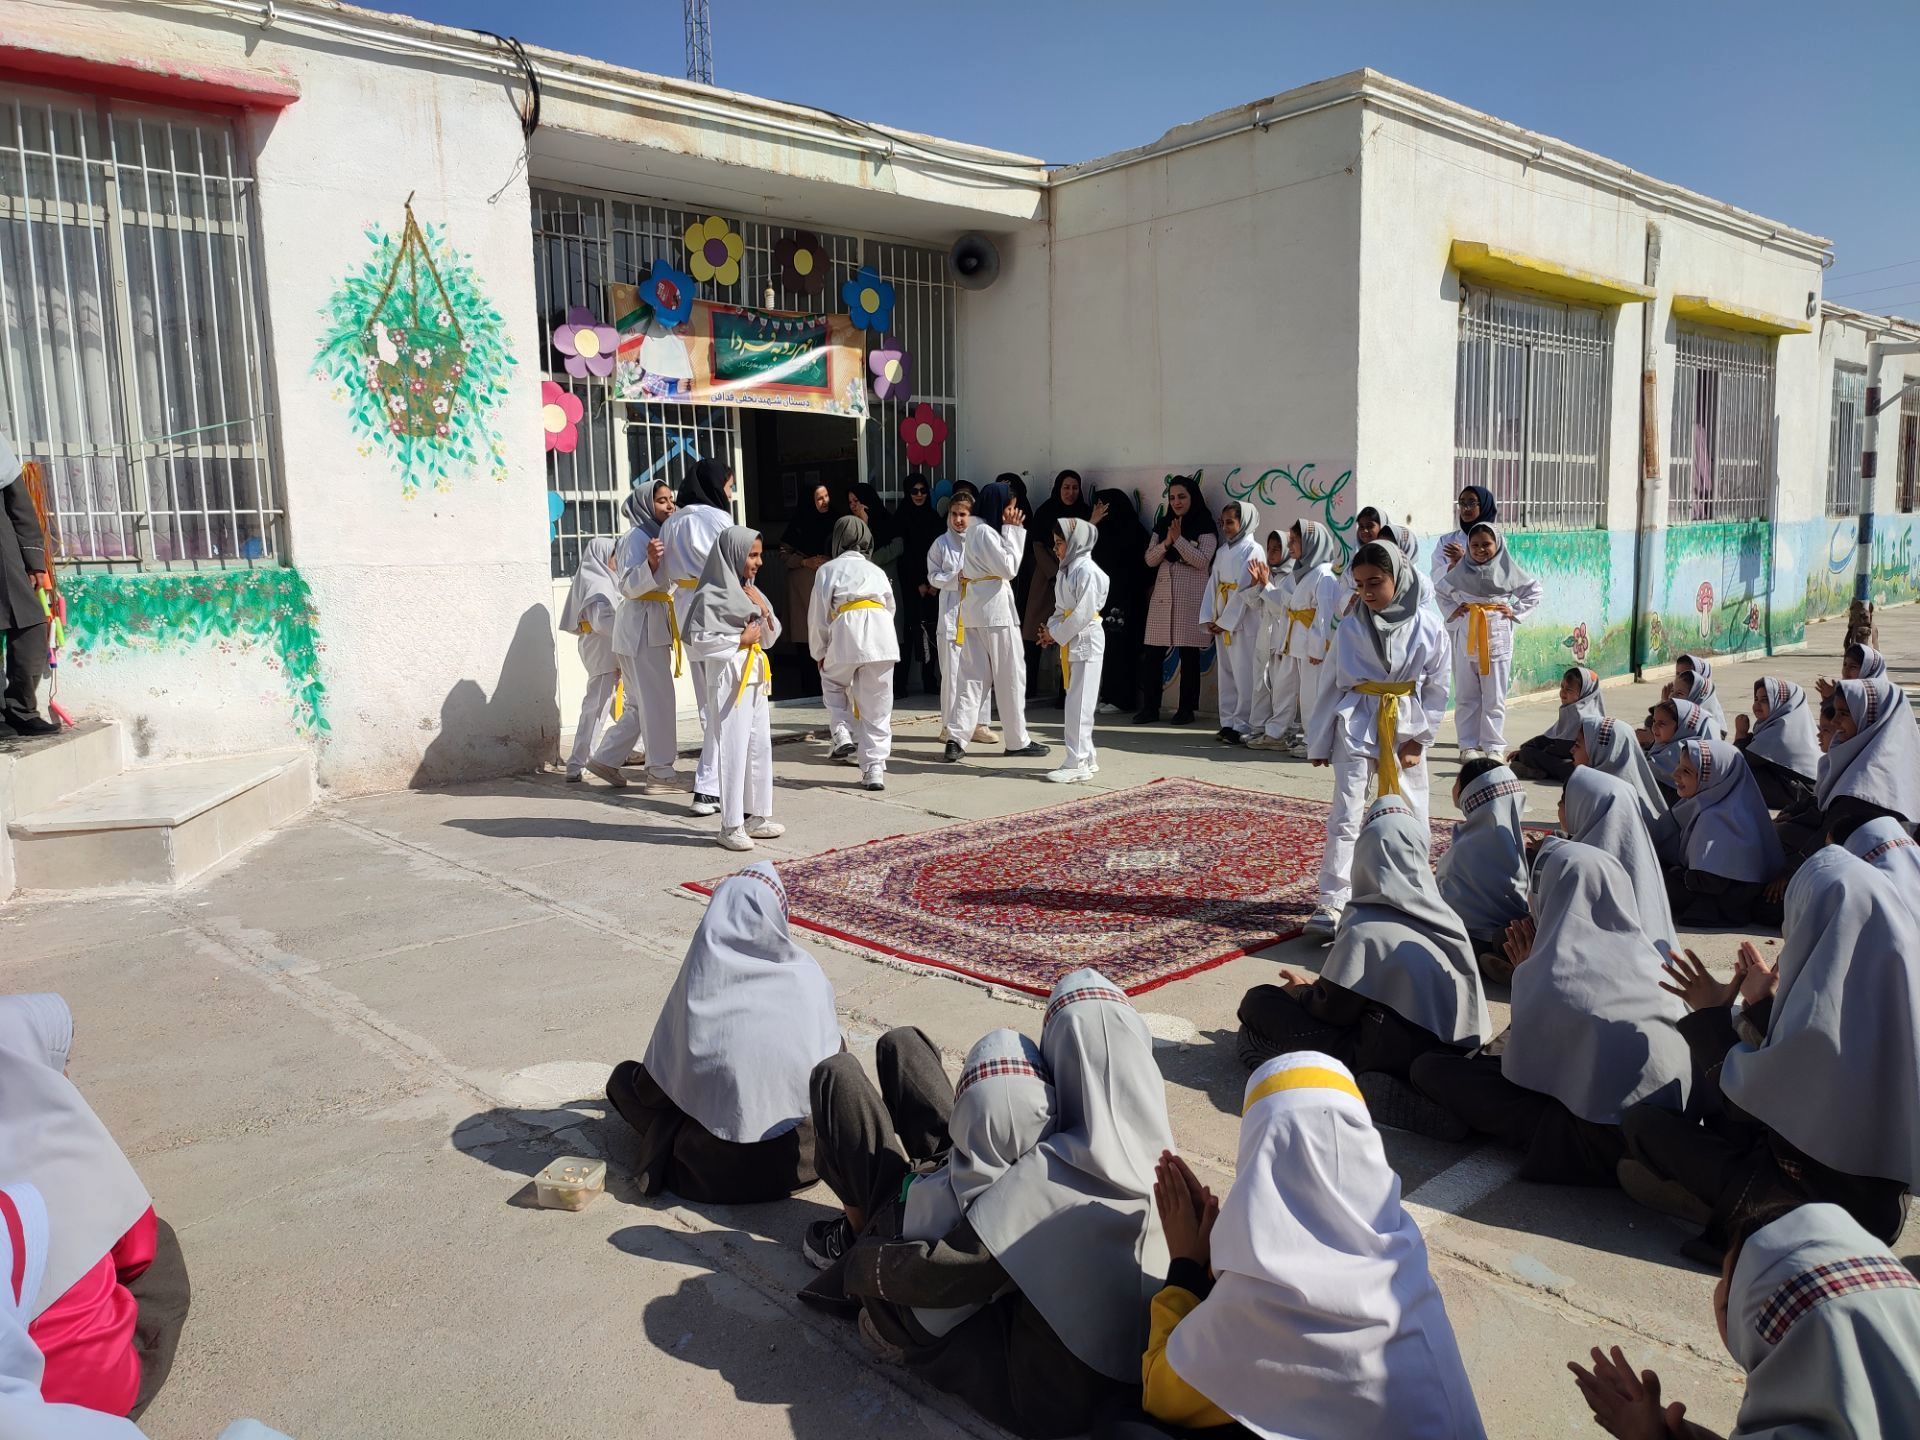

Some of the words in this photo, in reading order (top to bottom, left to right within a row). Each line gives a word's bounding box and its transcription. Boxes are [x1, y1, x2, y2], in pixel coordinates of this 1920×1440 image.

[730, 329, 777, 356] فردا
[757, 394, 782, 406] شهید
[782, 395, 810, 407] دبستان
